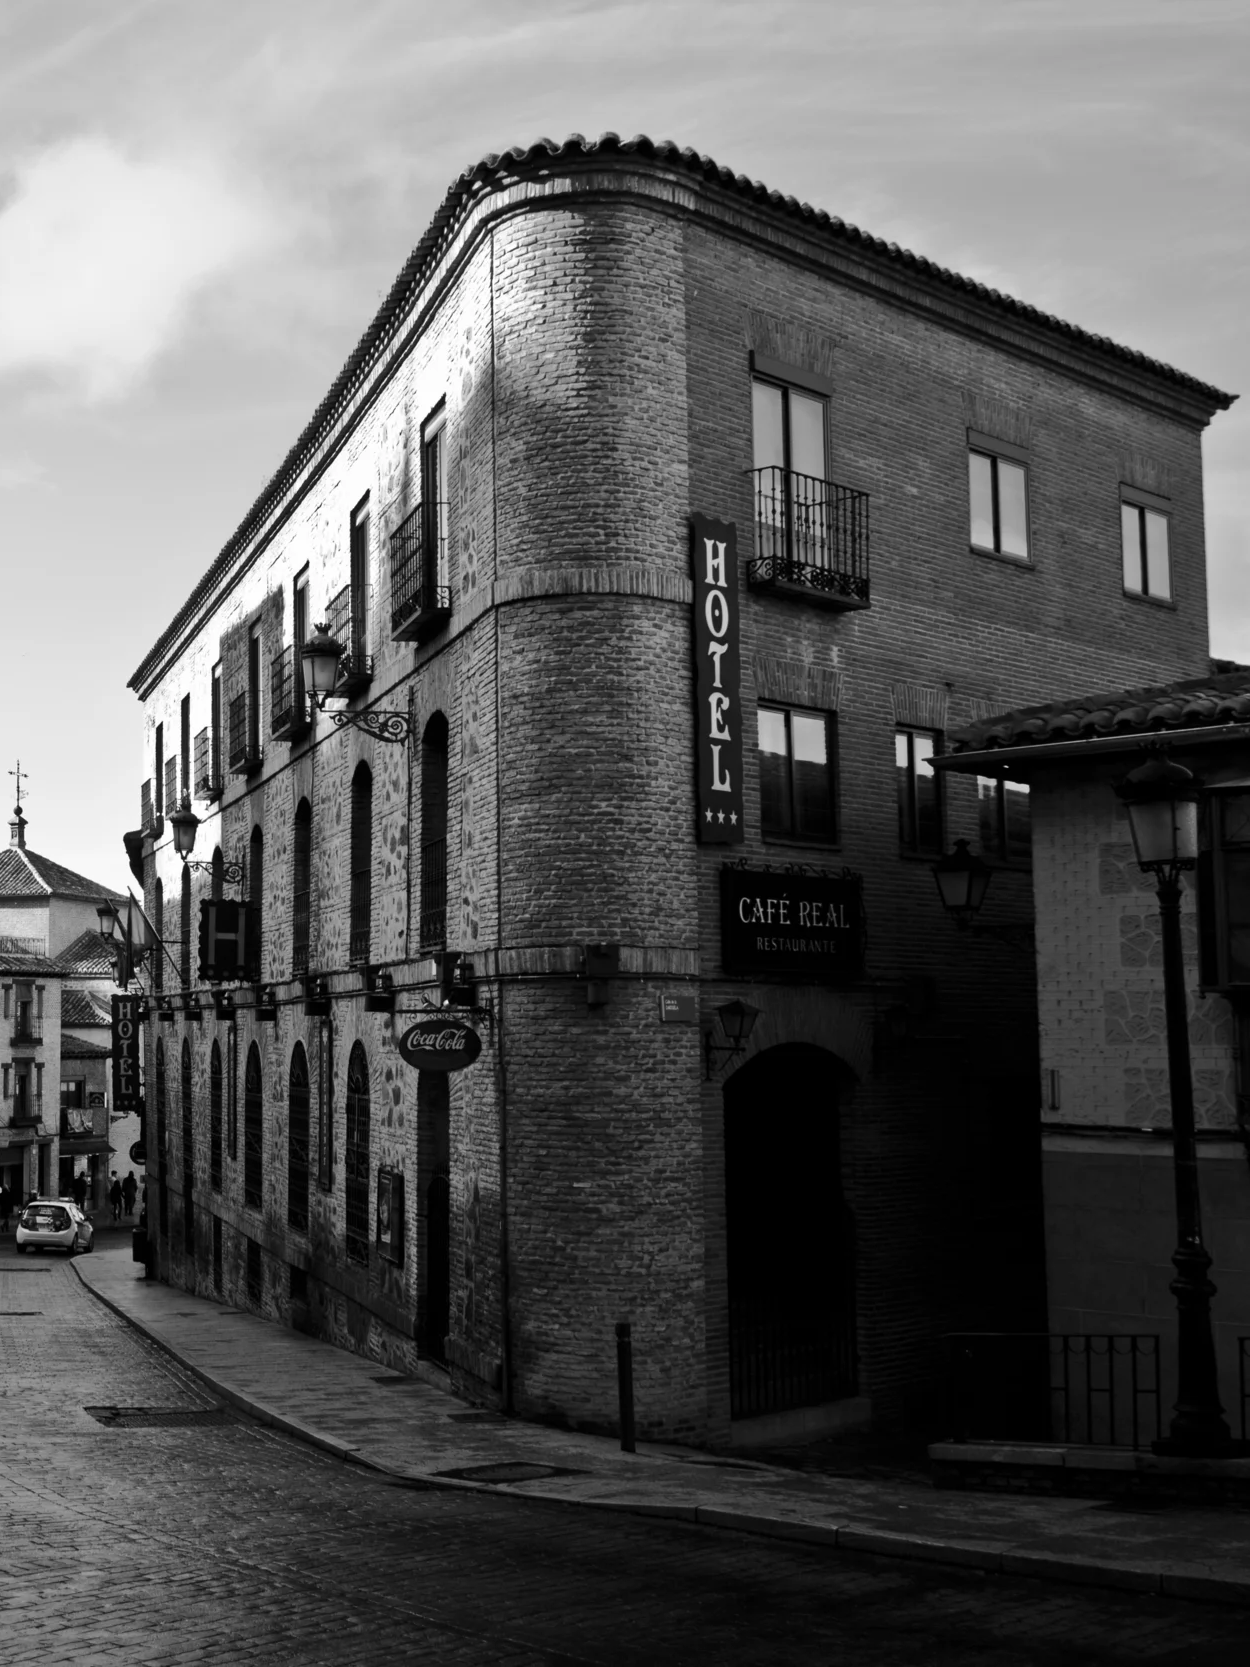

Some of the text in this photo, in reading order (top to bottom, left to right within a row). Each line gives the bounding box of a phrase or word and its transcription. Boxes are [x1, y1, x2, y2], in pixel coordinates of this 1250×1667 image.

[703, 537, 732, 793] HOTEL
[738, 891, 850, 929] CAFÉ REAL
[207, 906, 247, 967] H
[756, 936, 837, 954] RESTAURANTE
[117, 1001, 134, 1095] HOTEL
[407, 1028, 468, 1051] Coca-Cola
